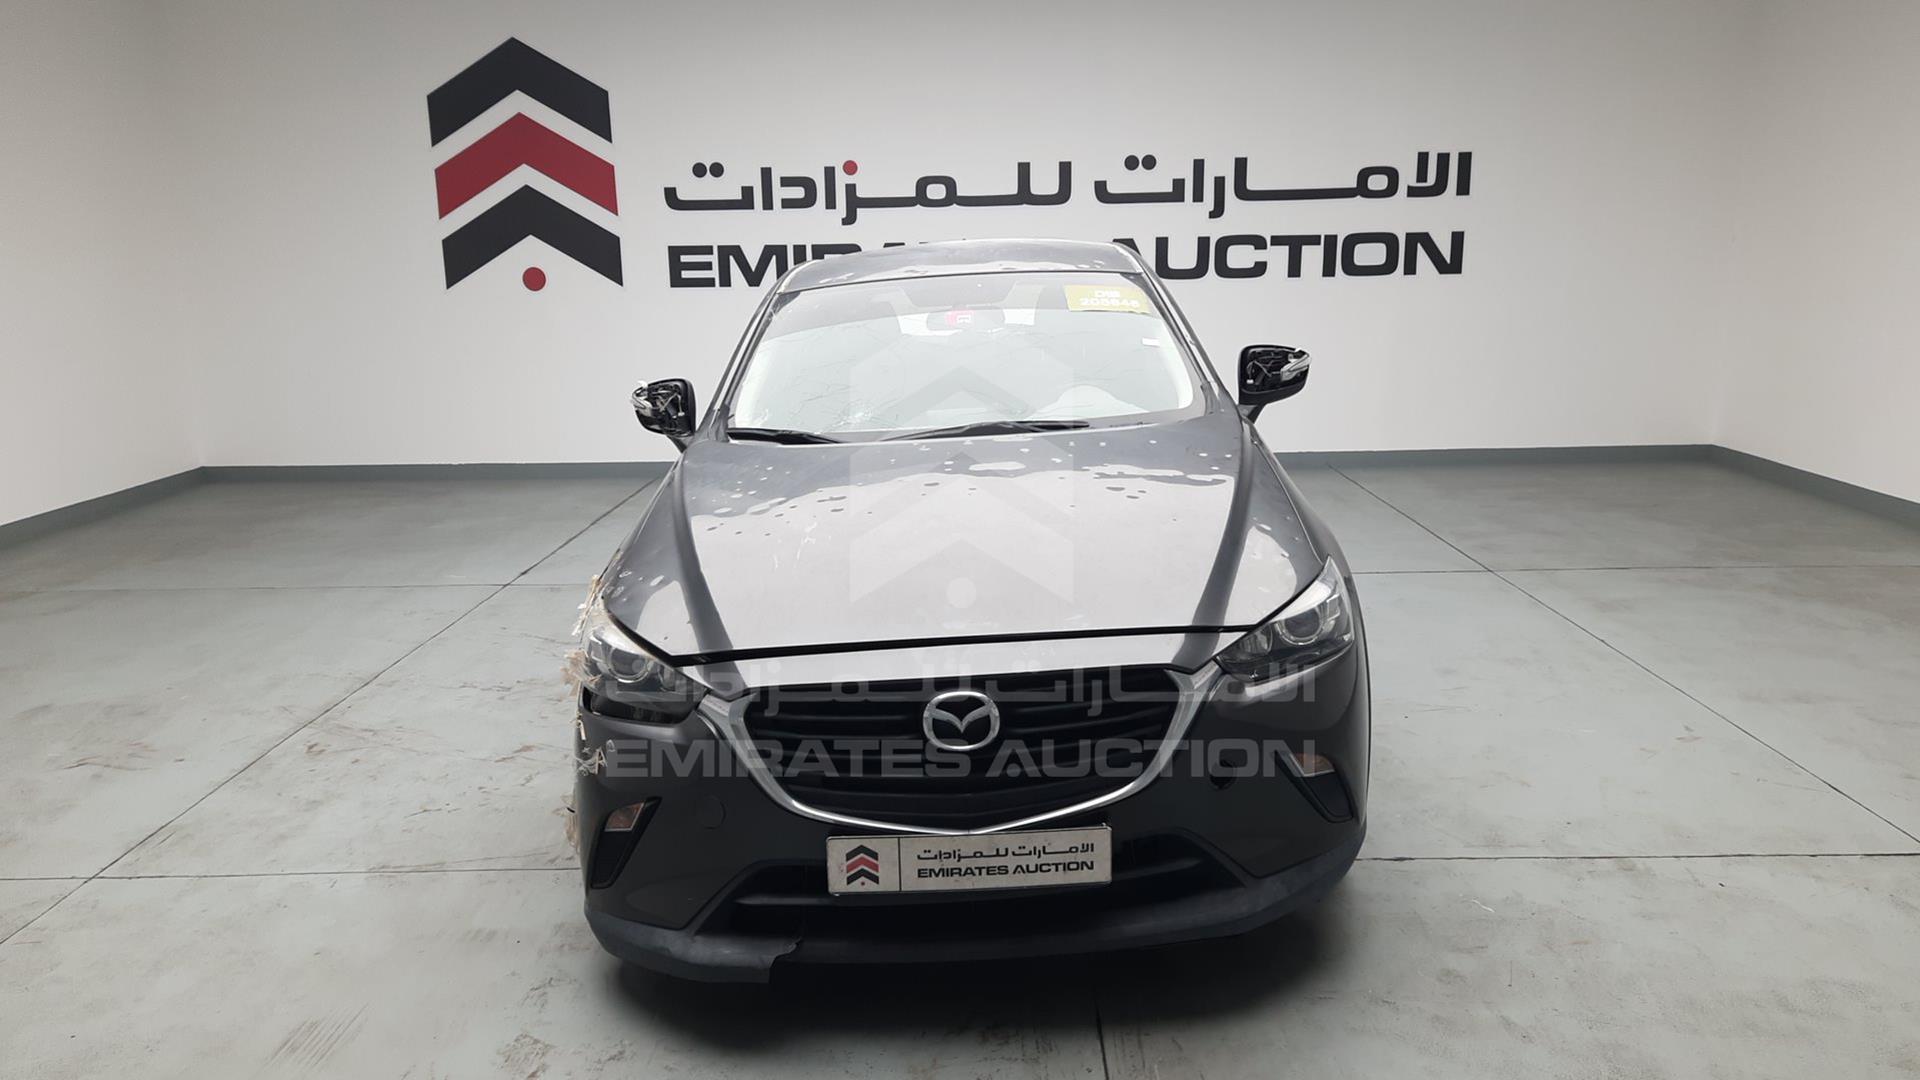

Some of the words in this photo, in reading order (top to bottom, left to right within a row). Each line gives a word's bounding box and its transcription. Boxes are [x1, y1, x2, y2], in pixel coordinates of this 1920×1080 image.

[663, 160, 1073, 226] للمزادات
[1093, 151, 1473, 219] الامارات
[1111, 231, 1466, 280] UCTION
[916, 847, 1009, 862] للمزادات
[917, 864, 1009, 878] EMIRATES
[1012, 861, 1095, 875] AUCTION
